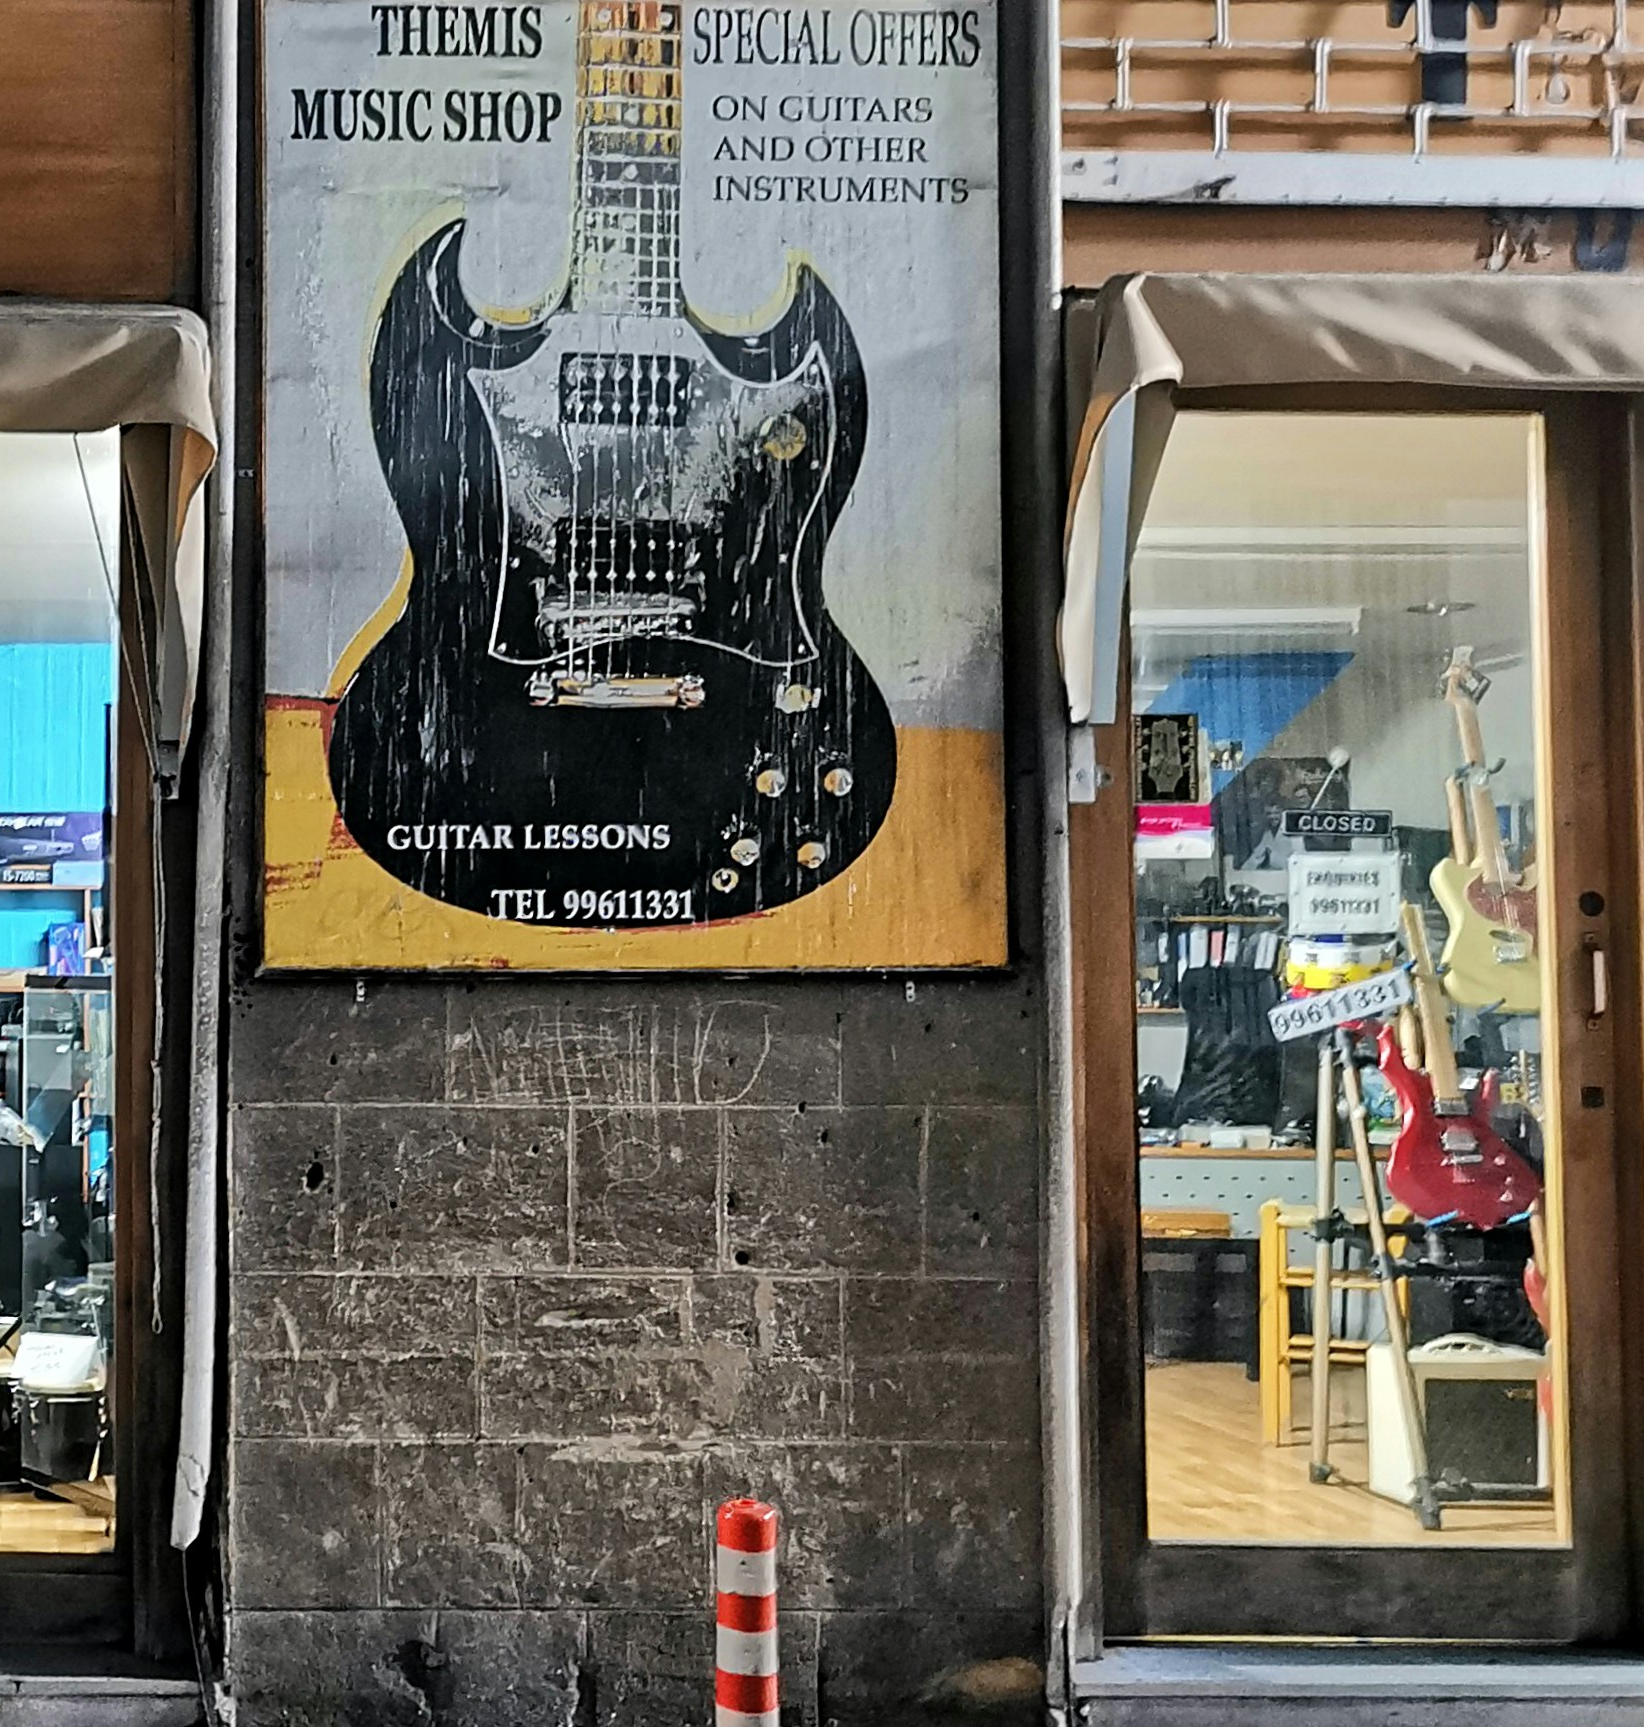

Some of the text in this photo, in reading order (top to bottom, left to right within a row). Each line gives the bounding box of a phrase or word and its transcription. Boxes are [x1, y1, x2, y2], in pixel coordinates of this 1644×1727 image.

[372, 5, 542, 59] THEMIS
[694, 8, 983, 67] SPECIAL OFFERS
[291, 88, 562, 143] MUSIC SHOP
[712, 95, 933, 123] ON GUITARS
[713, 136, 927, 163] AND OTHER
[714, 176, 969, 204] INSTRUMENTS
[387, 824, 670, 850] GUITAR LESSONS
[1298, 814, 1376, 832] CLOSED
[491, 890, 694, 920] TEL 99611331
[1273, 978, 1401, 1035] 99611331
